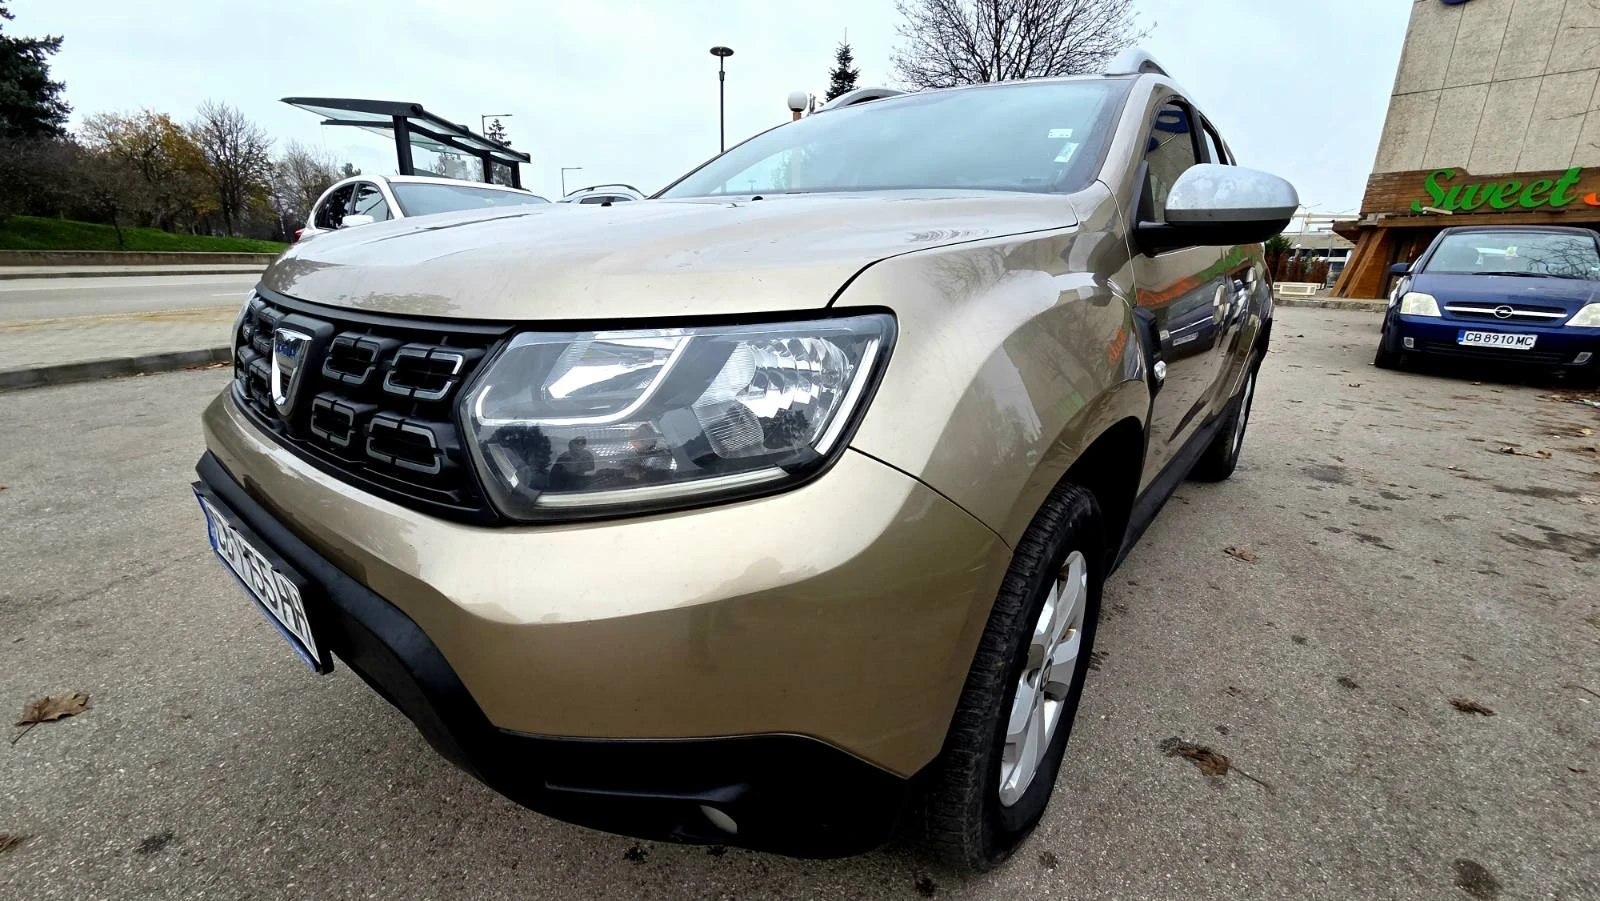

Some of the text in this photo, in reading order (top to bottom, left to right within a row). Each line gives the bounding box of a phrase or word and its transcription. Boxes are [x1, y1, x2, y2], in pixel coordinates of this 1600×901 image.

[1410, 166, 1583, 212] Sweet
[1465, 332, 1534, 346] CB 8910 MC
